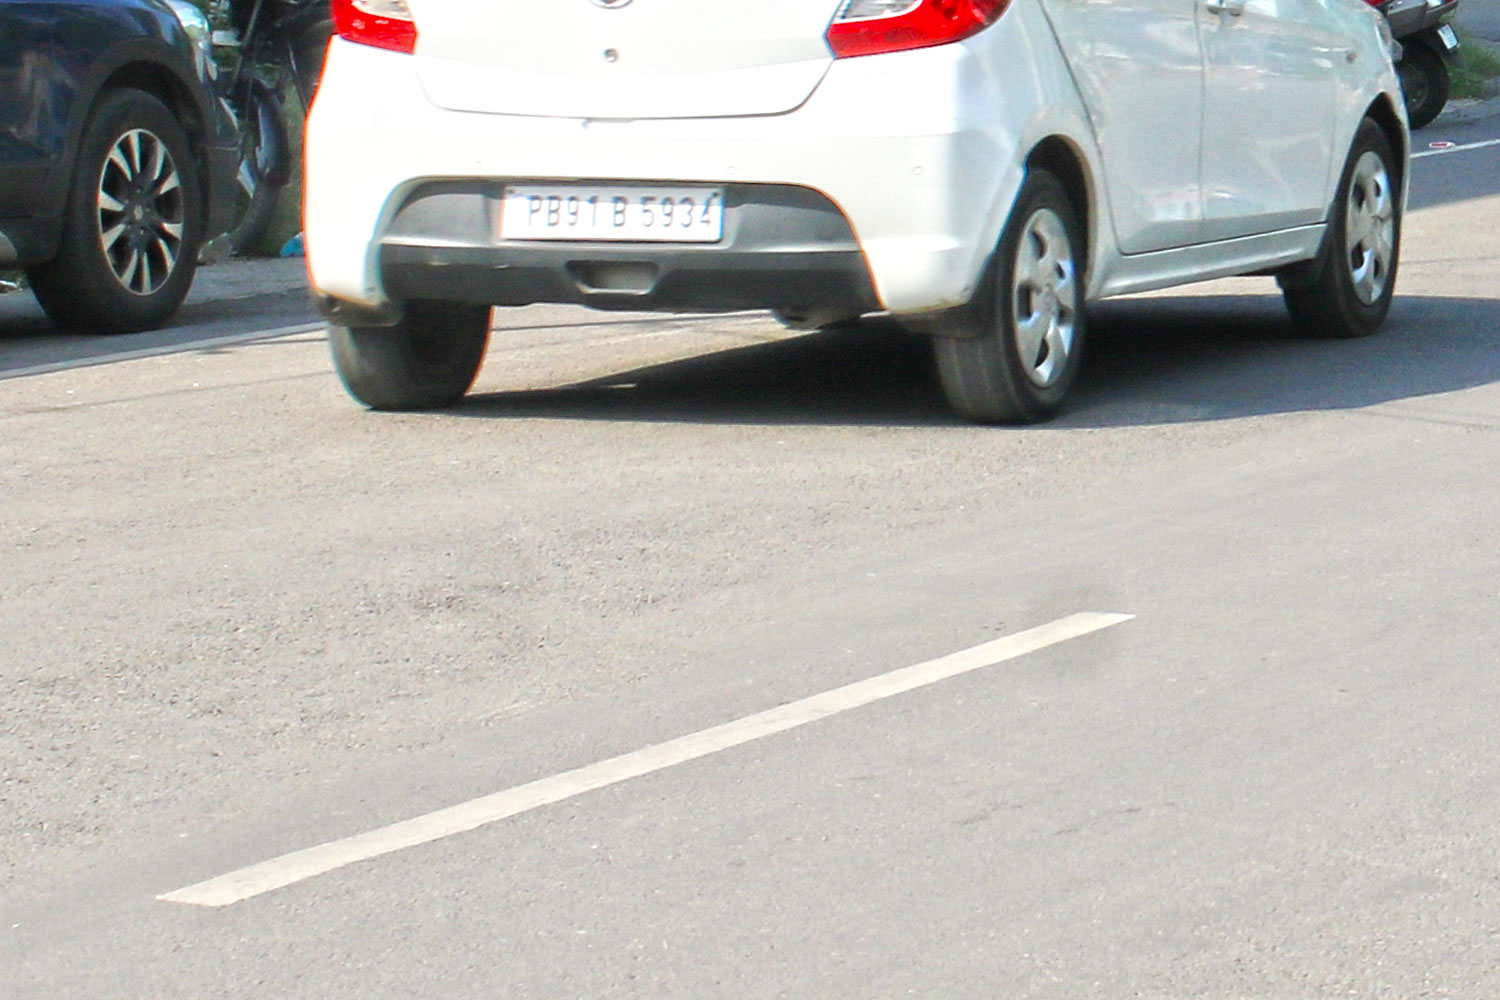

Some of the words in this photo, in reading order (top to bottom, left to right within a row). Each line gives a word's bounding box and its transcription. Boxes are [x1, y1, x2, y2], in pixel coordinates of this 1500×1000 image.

[527, 195, 599, 227] PB91
[612, 196, 629, 228] B
[641, 196, 713, 228] 5934
